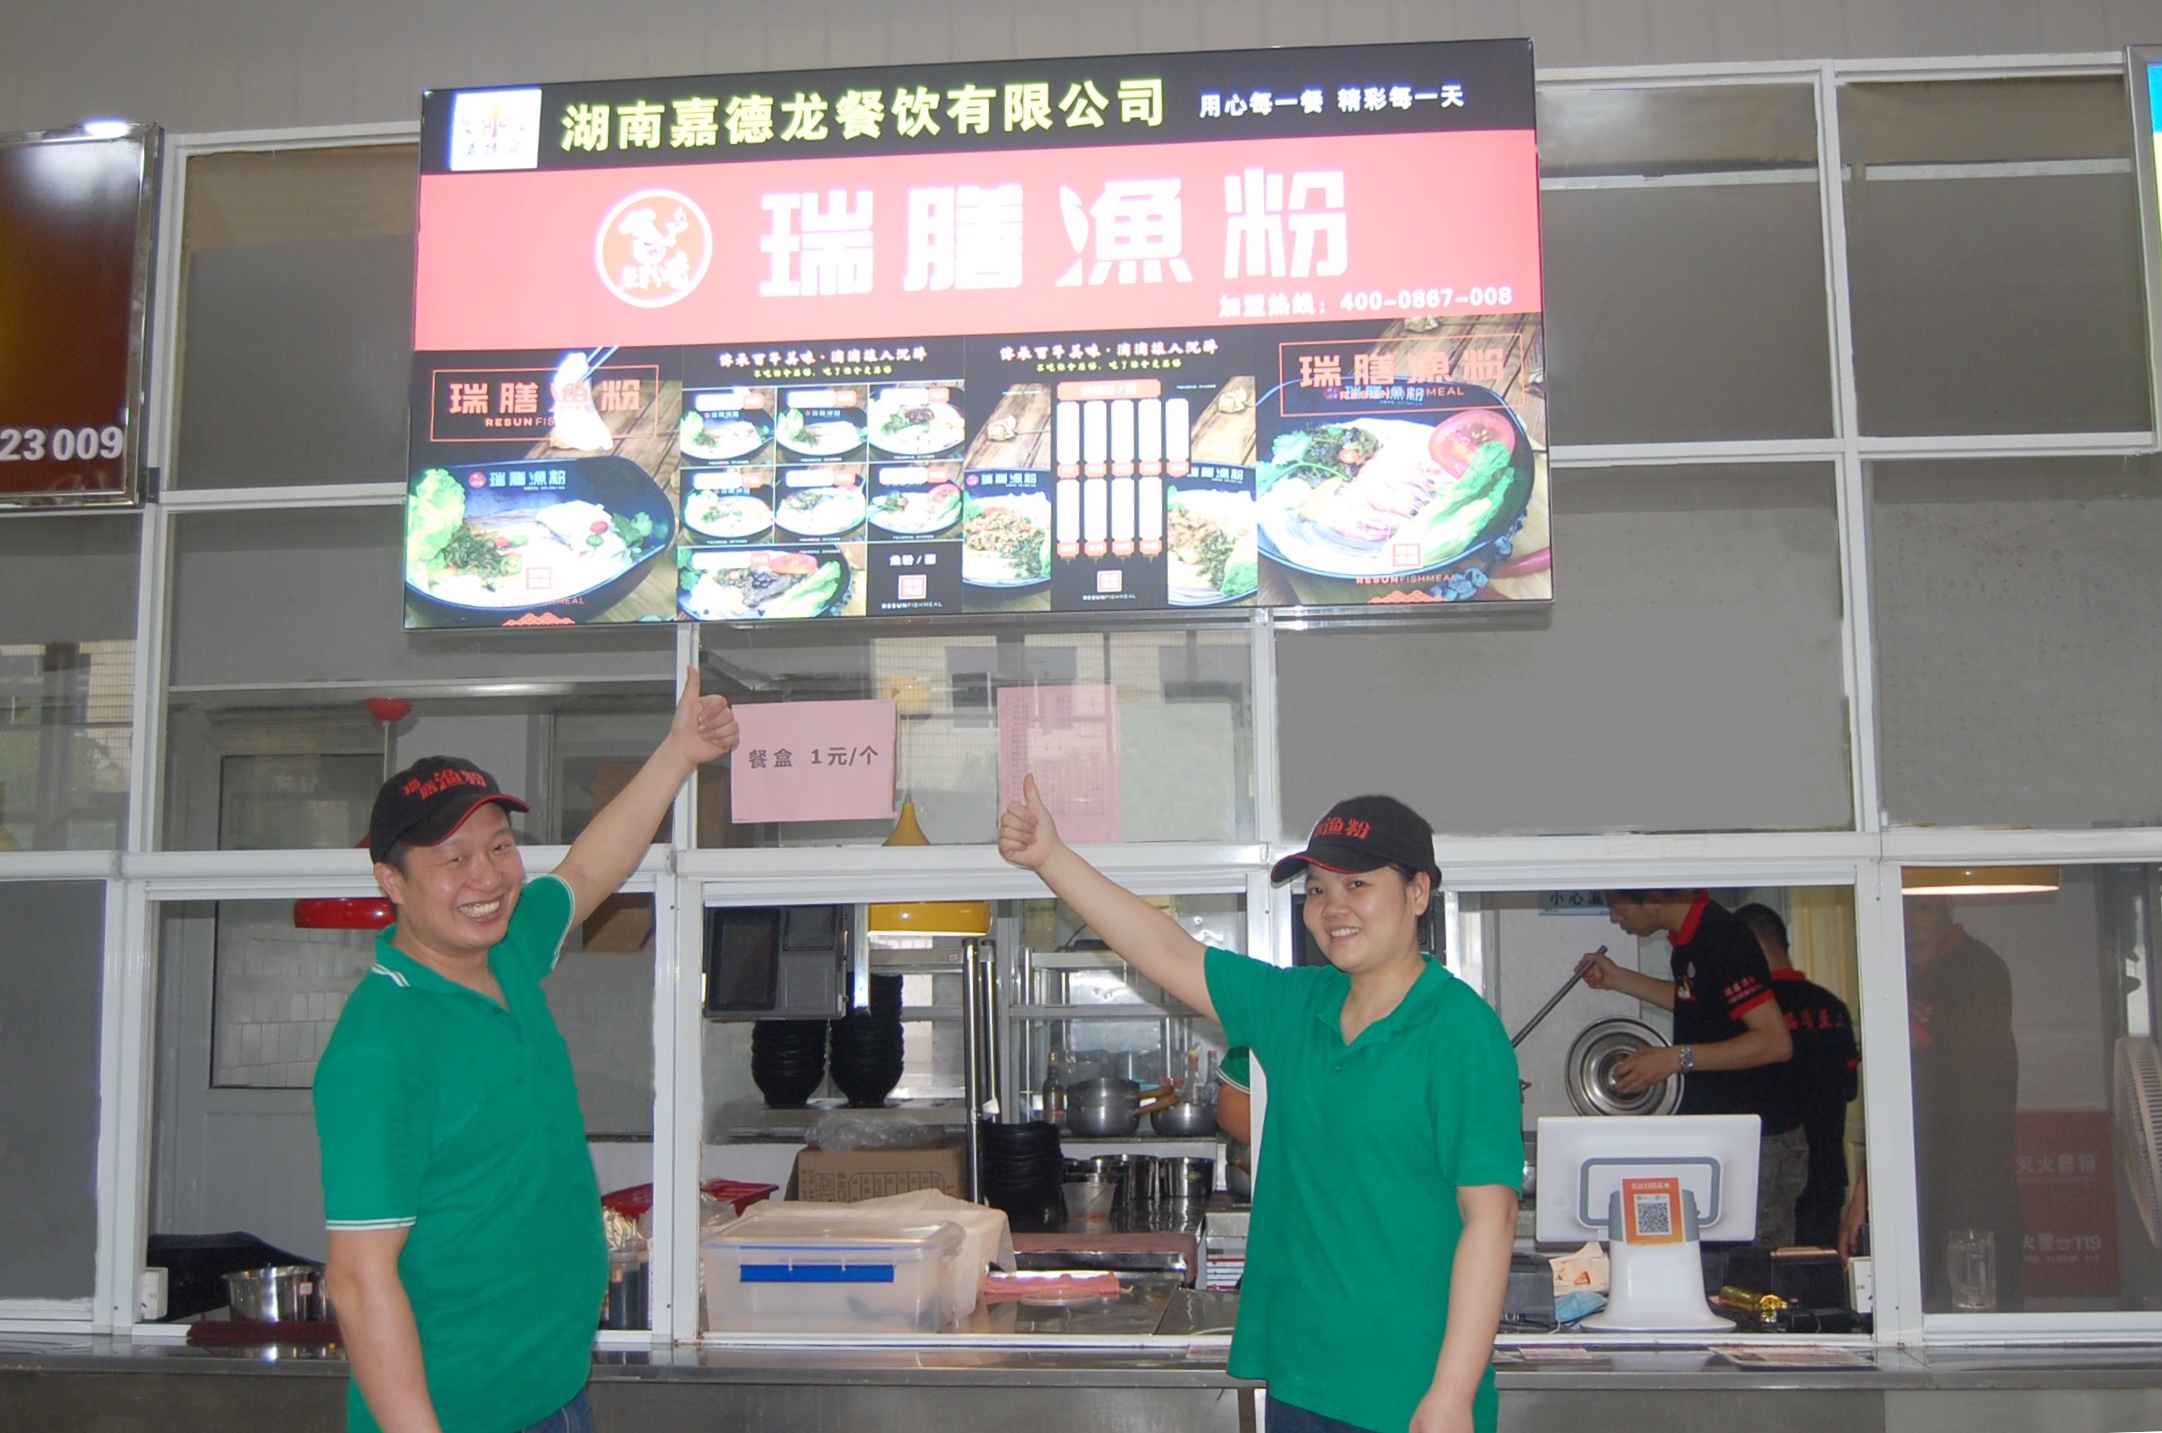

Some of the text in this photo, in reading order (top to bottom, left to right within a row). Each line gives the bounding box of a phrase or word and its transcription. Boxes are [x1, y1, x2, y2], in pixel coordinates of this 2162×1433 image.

[560, 77, 1164, 153] 湖南嘉德龙餐饮有限公司
[1199, 84, 1465, 119] 用心每一餐 精彩每一天
[1339, 286, 1513, 313] 400-0867-008
[748, 745, 879, 769] 餐盒 1元/个
